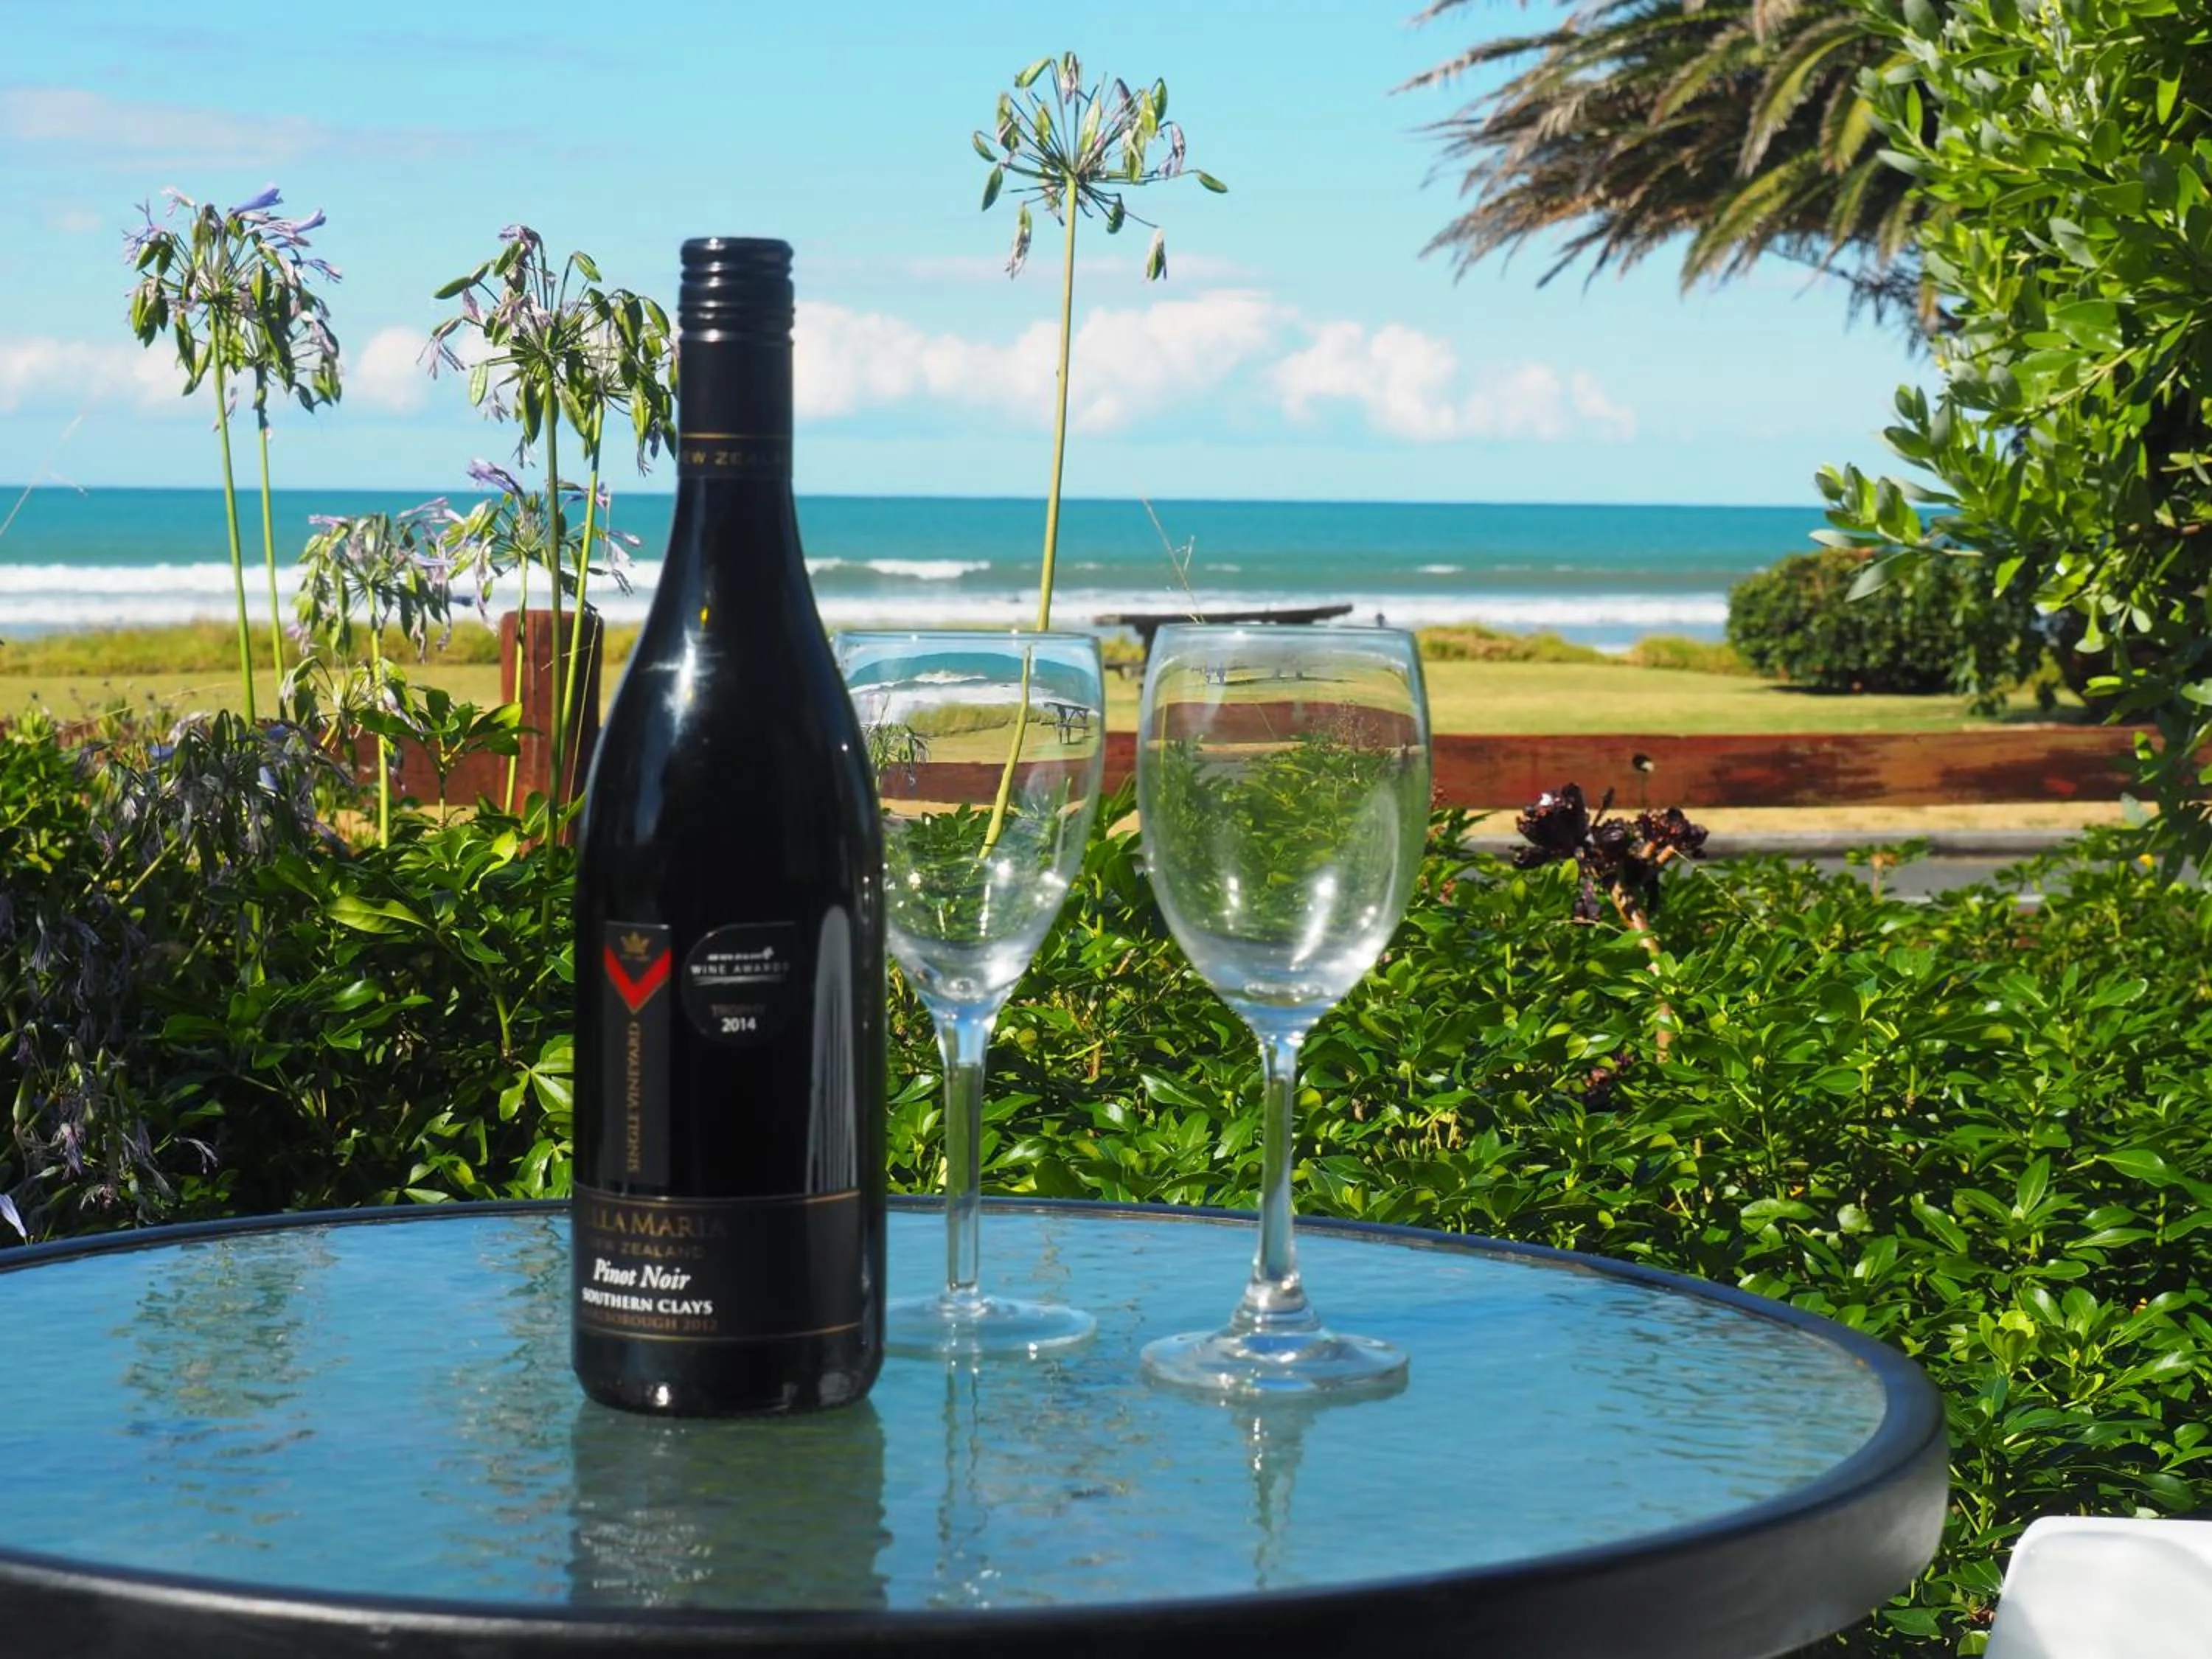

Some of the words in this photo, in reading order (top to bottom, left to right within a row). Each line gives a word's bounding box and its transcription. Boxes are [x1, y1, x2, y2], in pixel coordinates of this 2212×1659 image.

[690, 964, 726, 975] WINE
[733, 961, 791, 973] AWARDS
[721, 1016, 757, 1032] 2014
[626, 1020, 640, 1109] VINEYARD
[627, 1114, 640, 1173] SINGLE
[630, 1209, 728, 1238] MARIA
[620, 1241, 707, 1259] ZEALAND
[592, 1256, 638, 1287] Pinot
[639, 1263, 692, 1290] Noir
[582, 1287, 653, 1312] SOUTHERN
[657, 1298, 714, 1315] CLAYS
